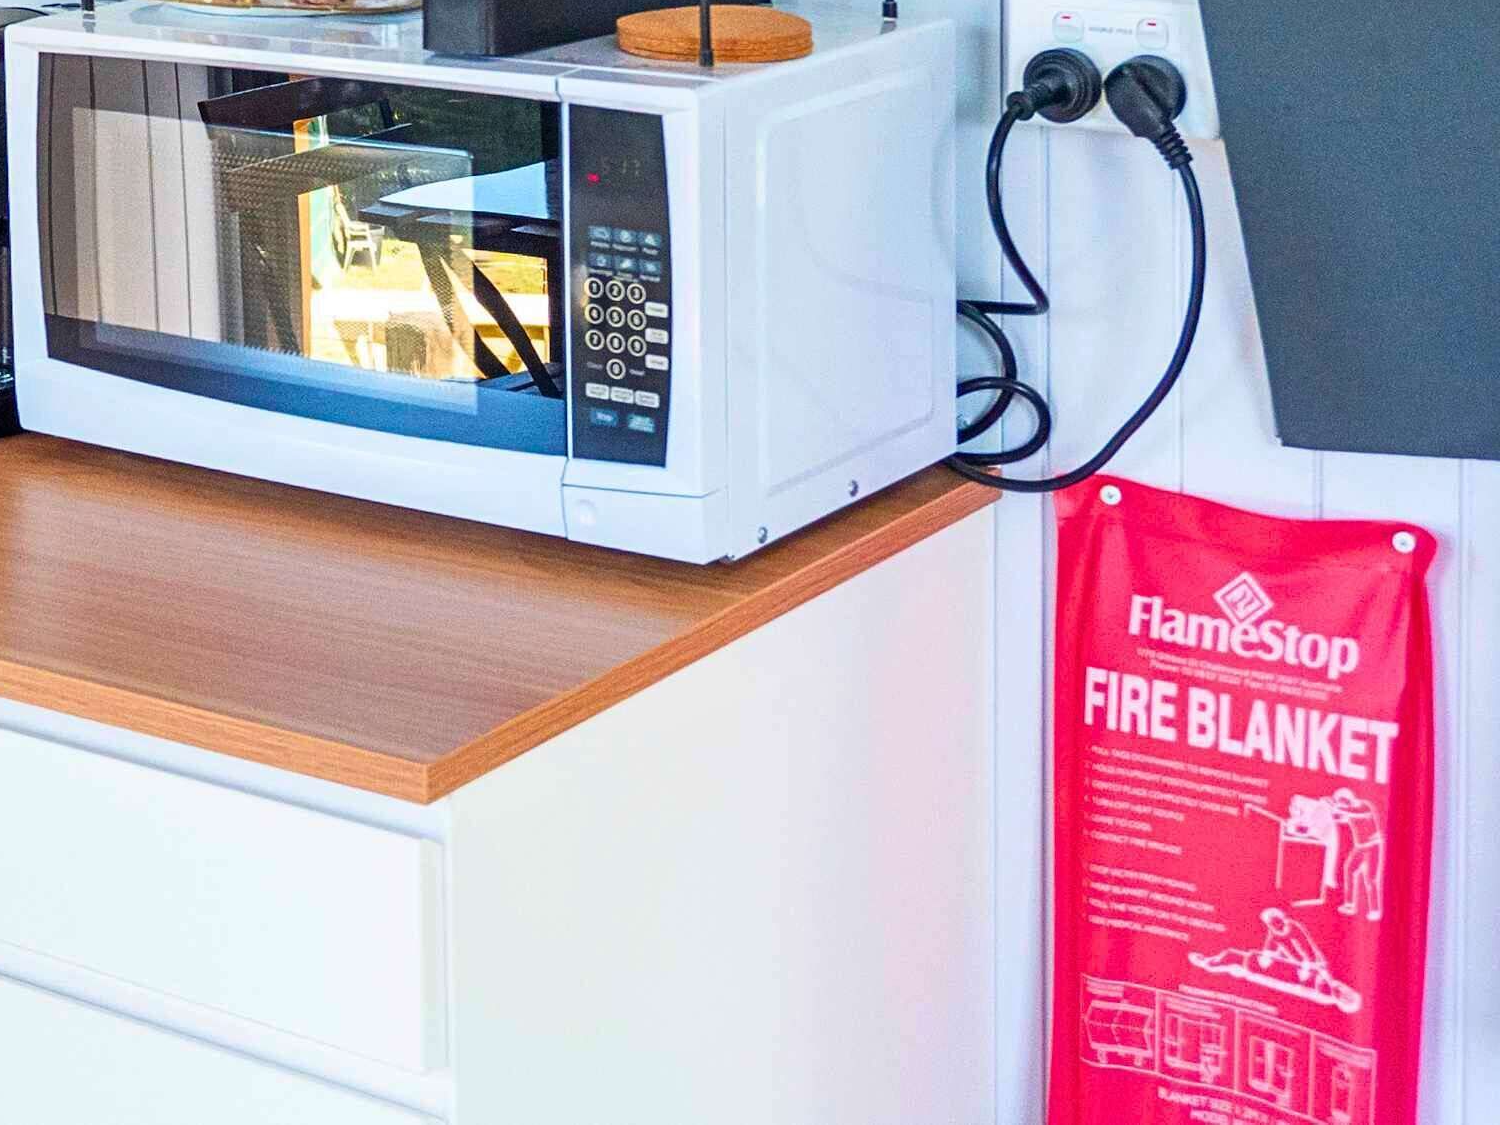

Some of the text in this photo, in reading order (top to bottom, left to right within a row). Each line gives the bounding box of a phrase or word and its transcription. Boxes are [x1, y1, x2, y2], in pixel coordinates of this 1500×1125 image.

[1128, 593, 1360, 680] FlameStop
[1084, 666, 1178, 743] FIRE
[1186, 687, 1399, 785] BLANKET
